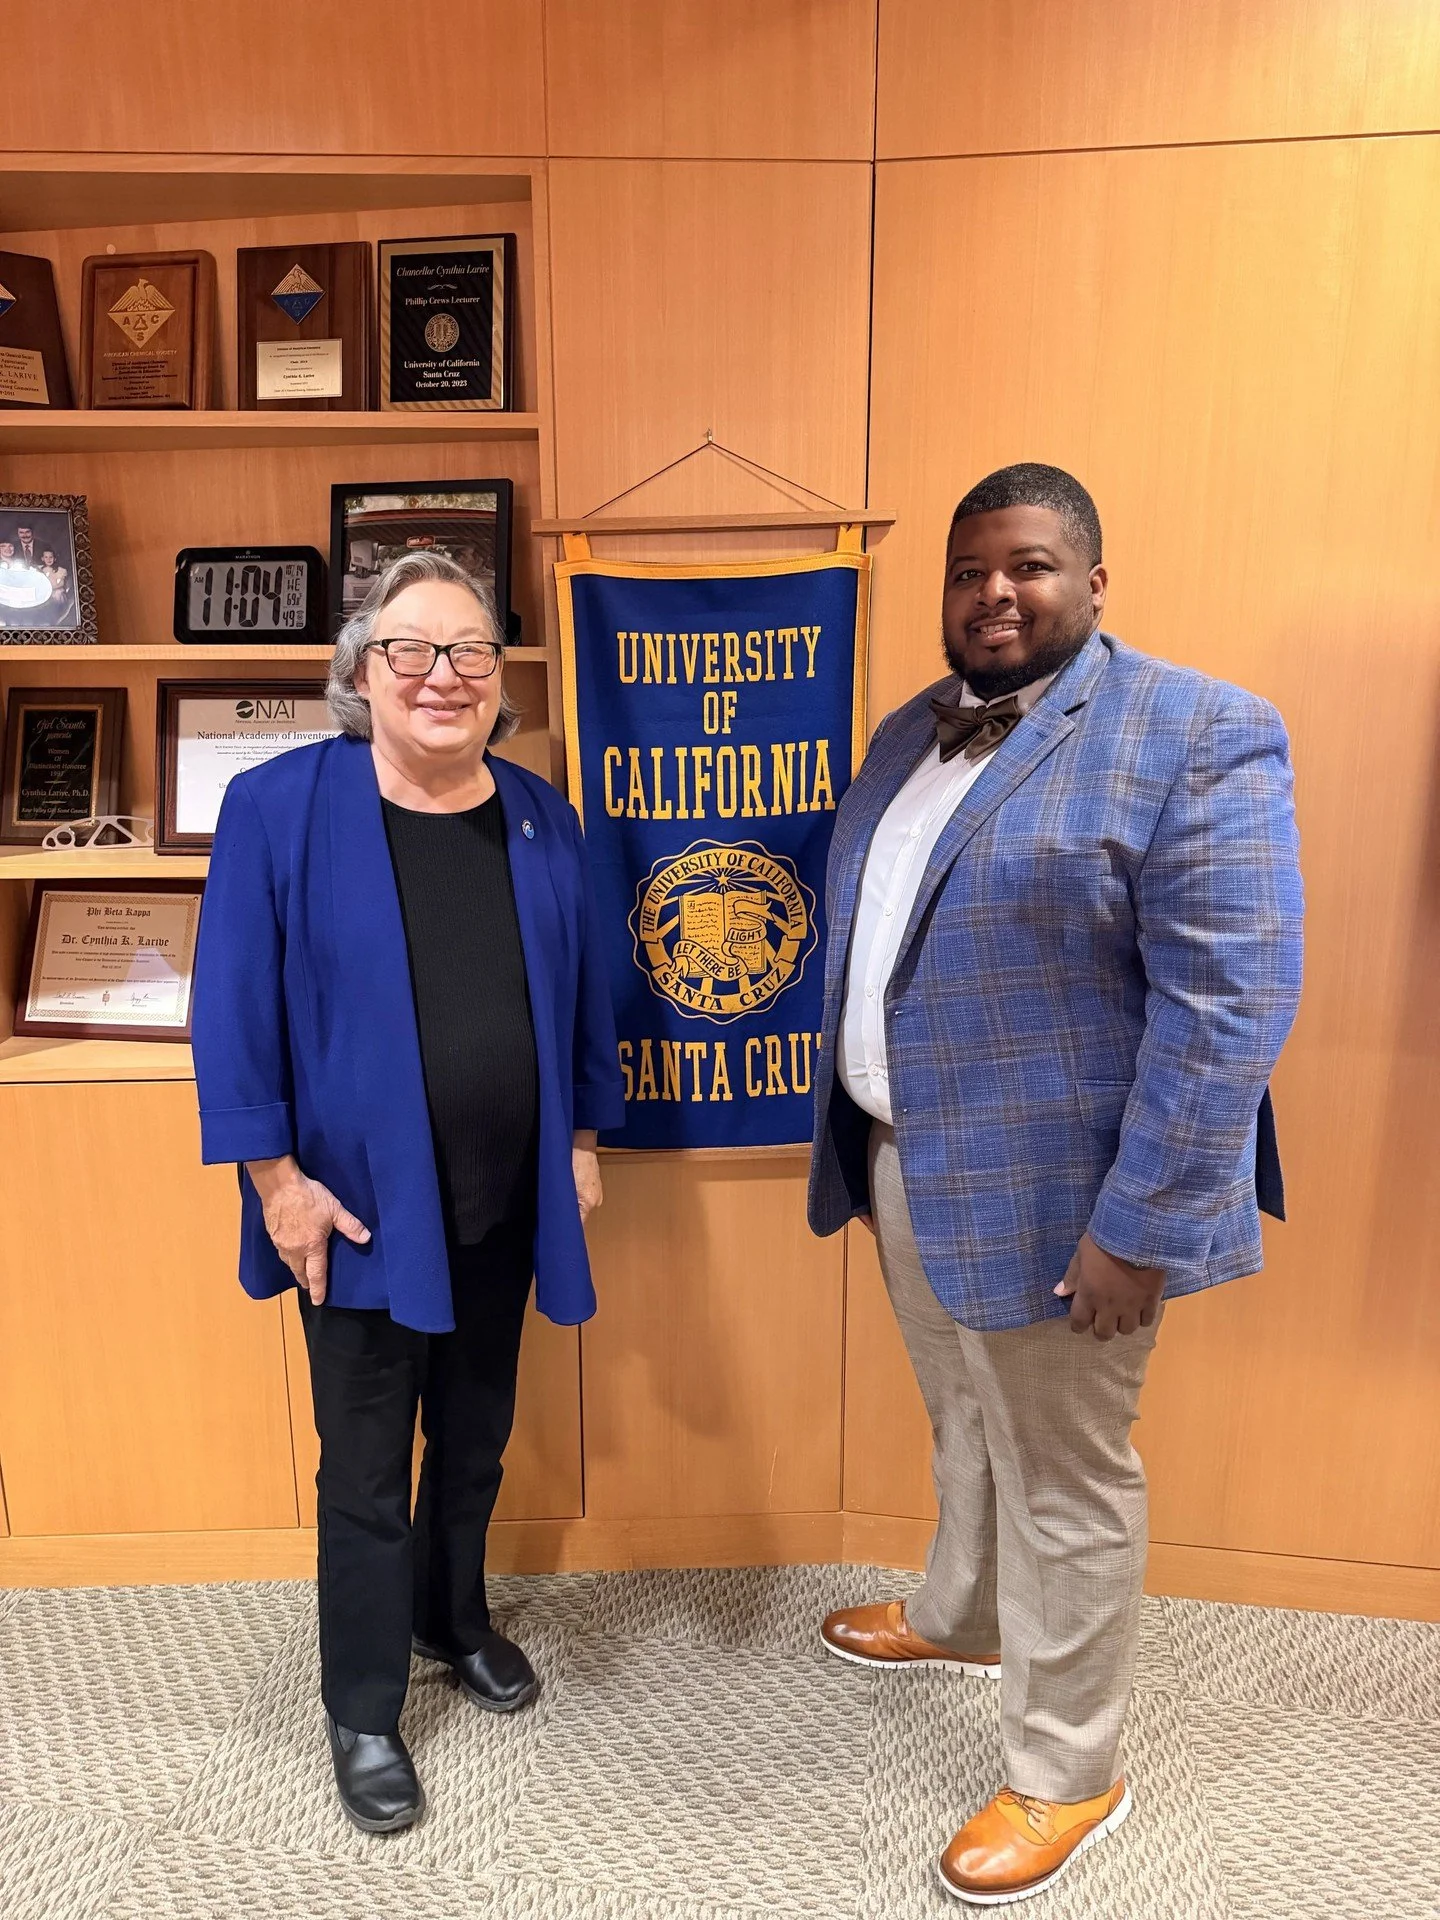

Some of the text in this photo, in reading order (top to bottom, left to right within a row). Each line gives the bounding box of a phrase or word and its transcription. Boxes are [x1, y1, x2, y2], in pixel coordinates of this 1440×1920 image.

[397, 263, 490, 278] Chancellor Cynthia Larive
[405, 296, 480, 307] Phillip Crews Lecturer
[404, 358, 480, 370] University of California
[8, 371, 38, 381] LARIVE
[423, 370, 460, 379] Santa Cruz
[452, 380, 468, 388] 2023
[202, 565, 283, 628] 11:04
[282, 610, 295, 627] 49
[617, 625, 822, 685] UNIVERSITY
[256, 700, 295, 719] NAI
[702, 690, 739, 735] OF
[56, 717, 87, 731] Scouts
[197, 731, 235, 740] National
[238, 731, 280, 743] Academy
[281, 730, 292, 740] of
[603, 739, 837, 820] CALIFORNIA
[21, 788, 47, 798] Cynthia
[641, 851, 803, 935] THE UNIVERSITY OF CALIFORNIA
[87, 907, 151, 918] Phi Beta Kappa
[61, 934, 170, 948] Dr. Cynthia K. Larive
[728, 927, 764, 945] LIGHT
[676, 943, 743, 978] LET THERE BE
[657, 966, 786, 1011] SANTA CRUZ
[618, 1032, 824, 1102] SANTA CRU
